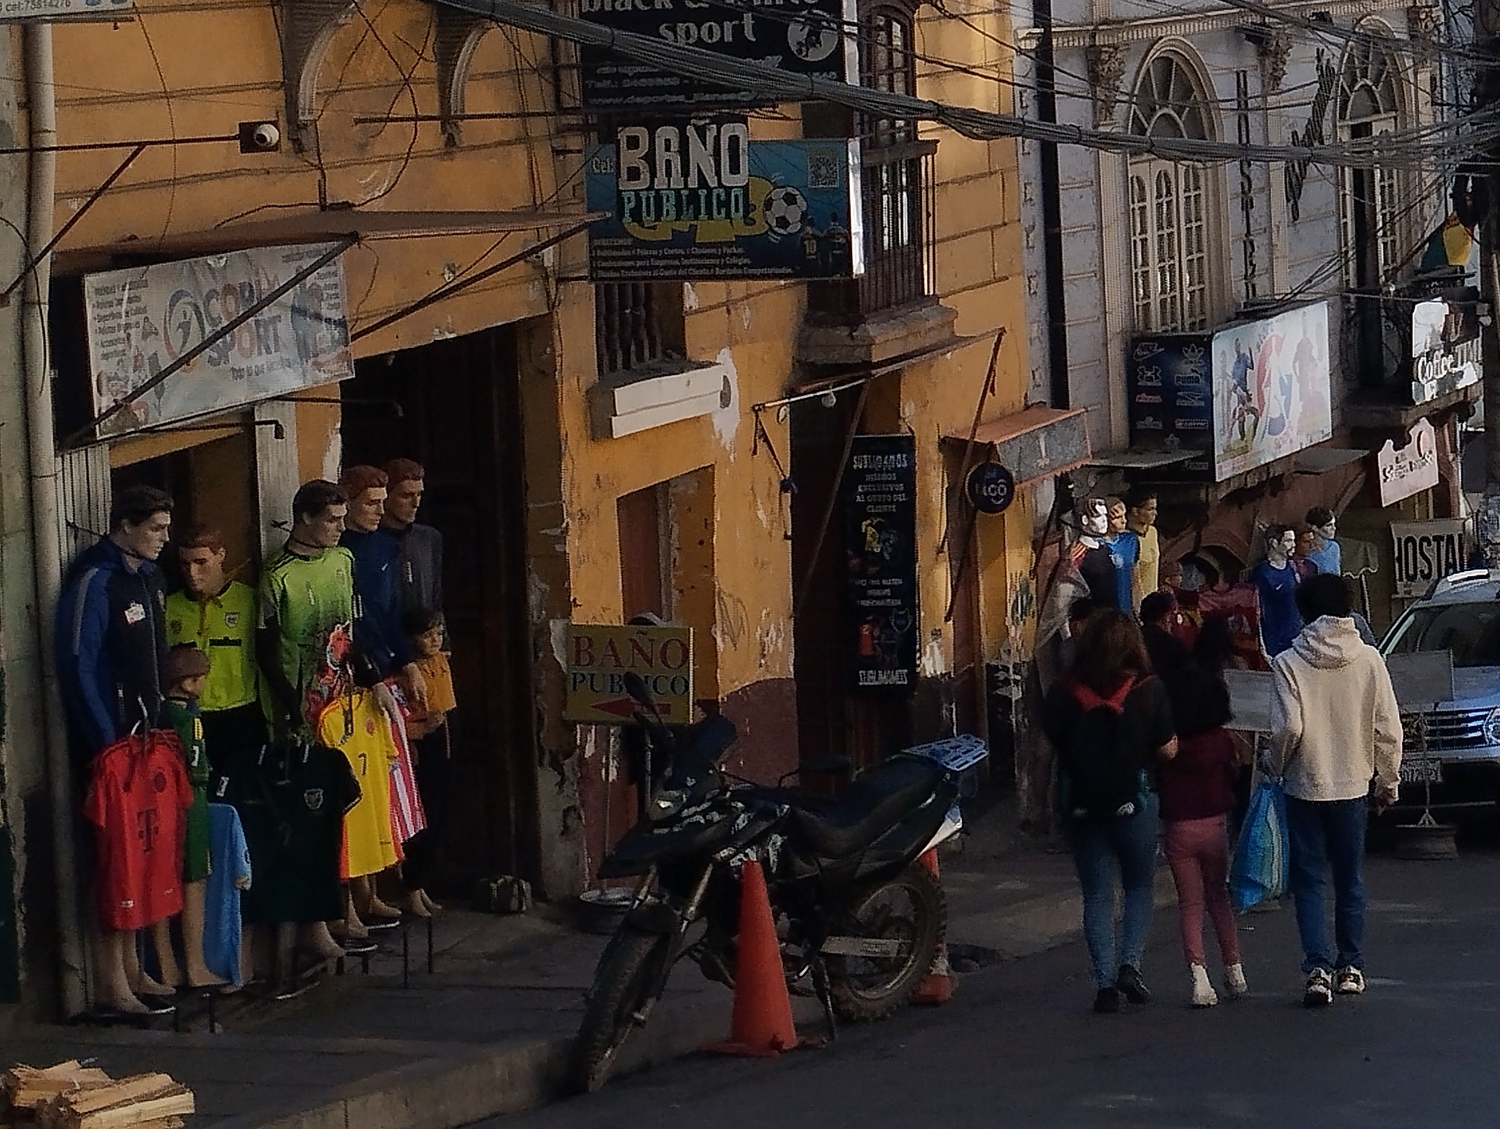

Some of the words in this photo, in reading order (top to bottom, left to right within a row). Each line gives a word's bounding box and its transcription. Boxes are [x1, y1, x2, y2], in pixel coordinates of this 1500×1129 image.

[659, 14, 756, 47] sport
[622, 188, 744, 222] PUBLICO
[571, 630, 690, 670] BAÑO
[571, 672, 690, 695] PUBCO
